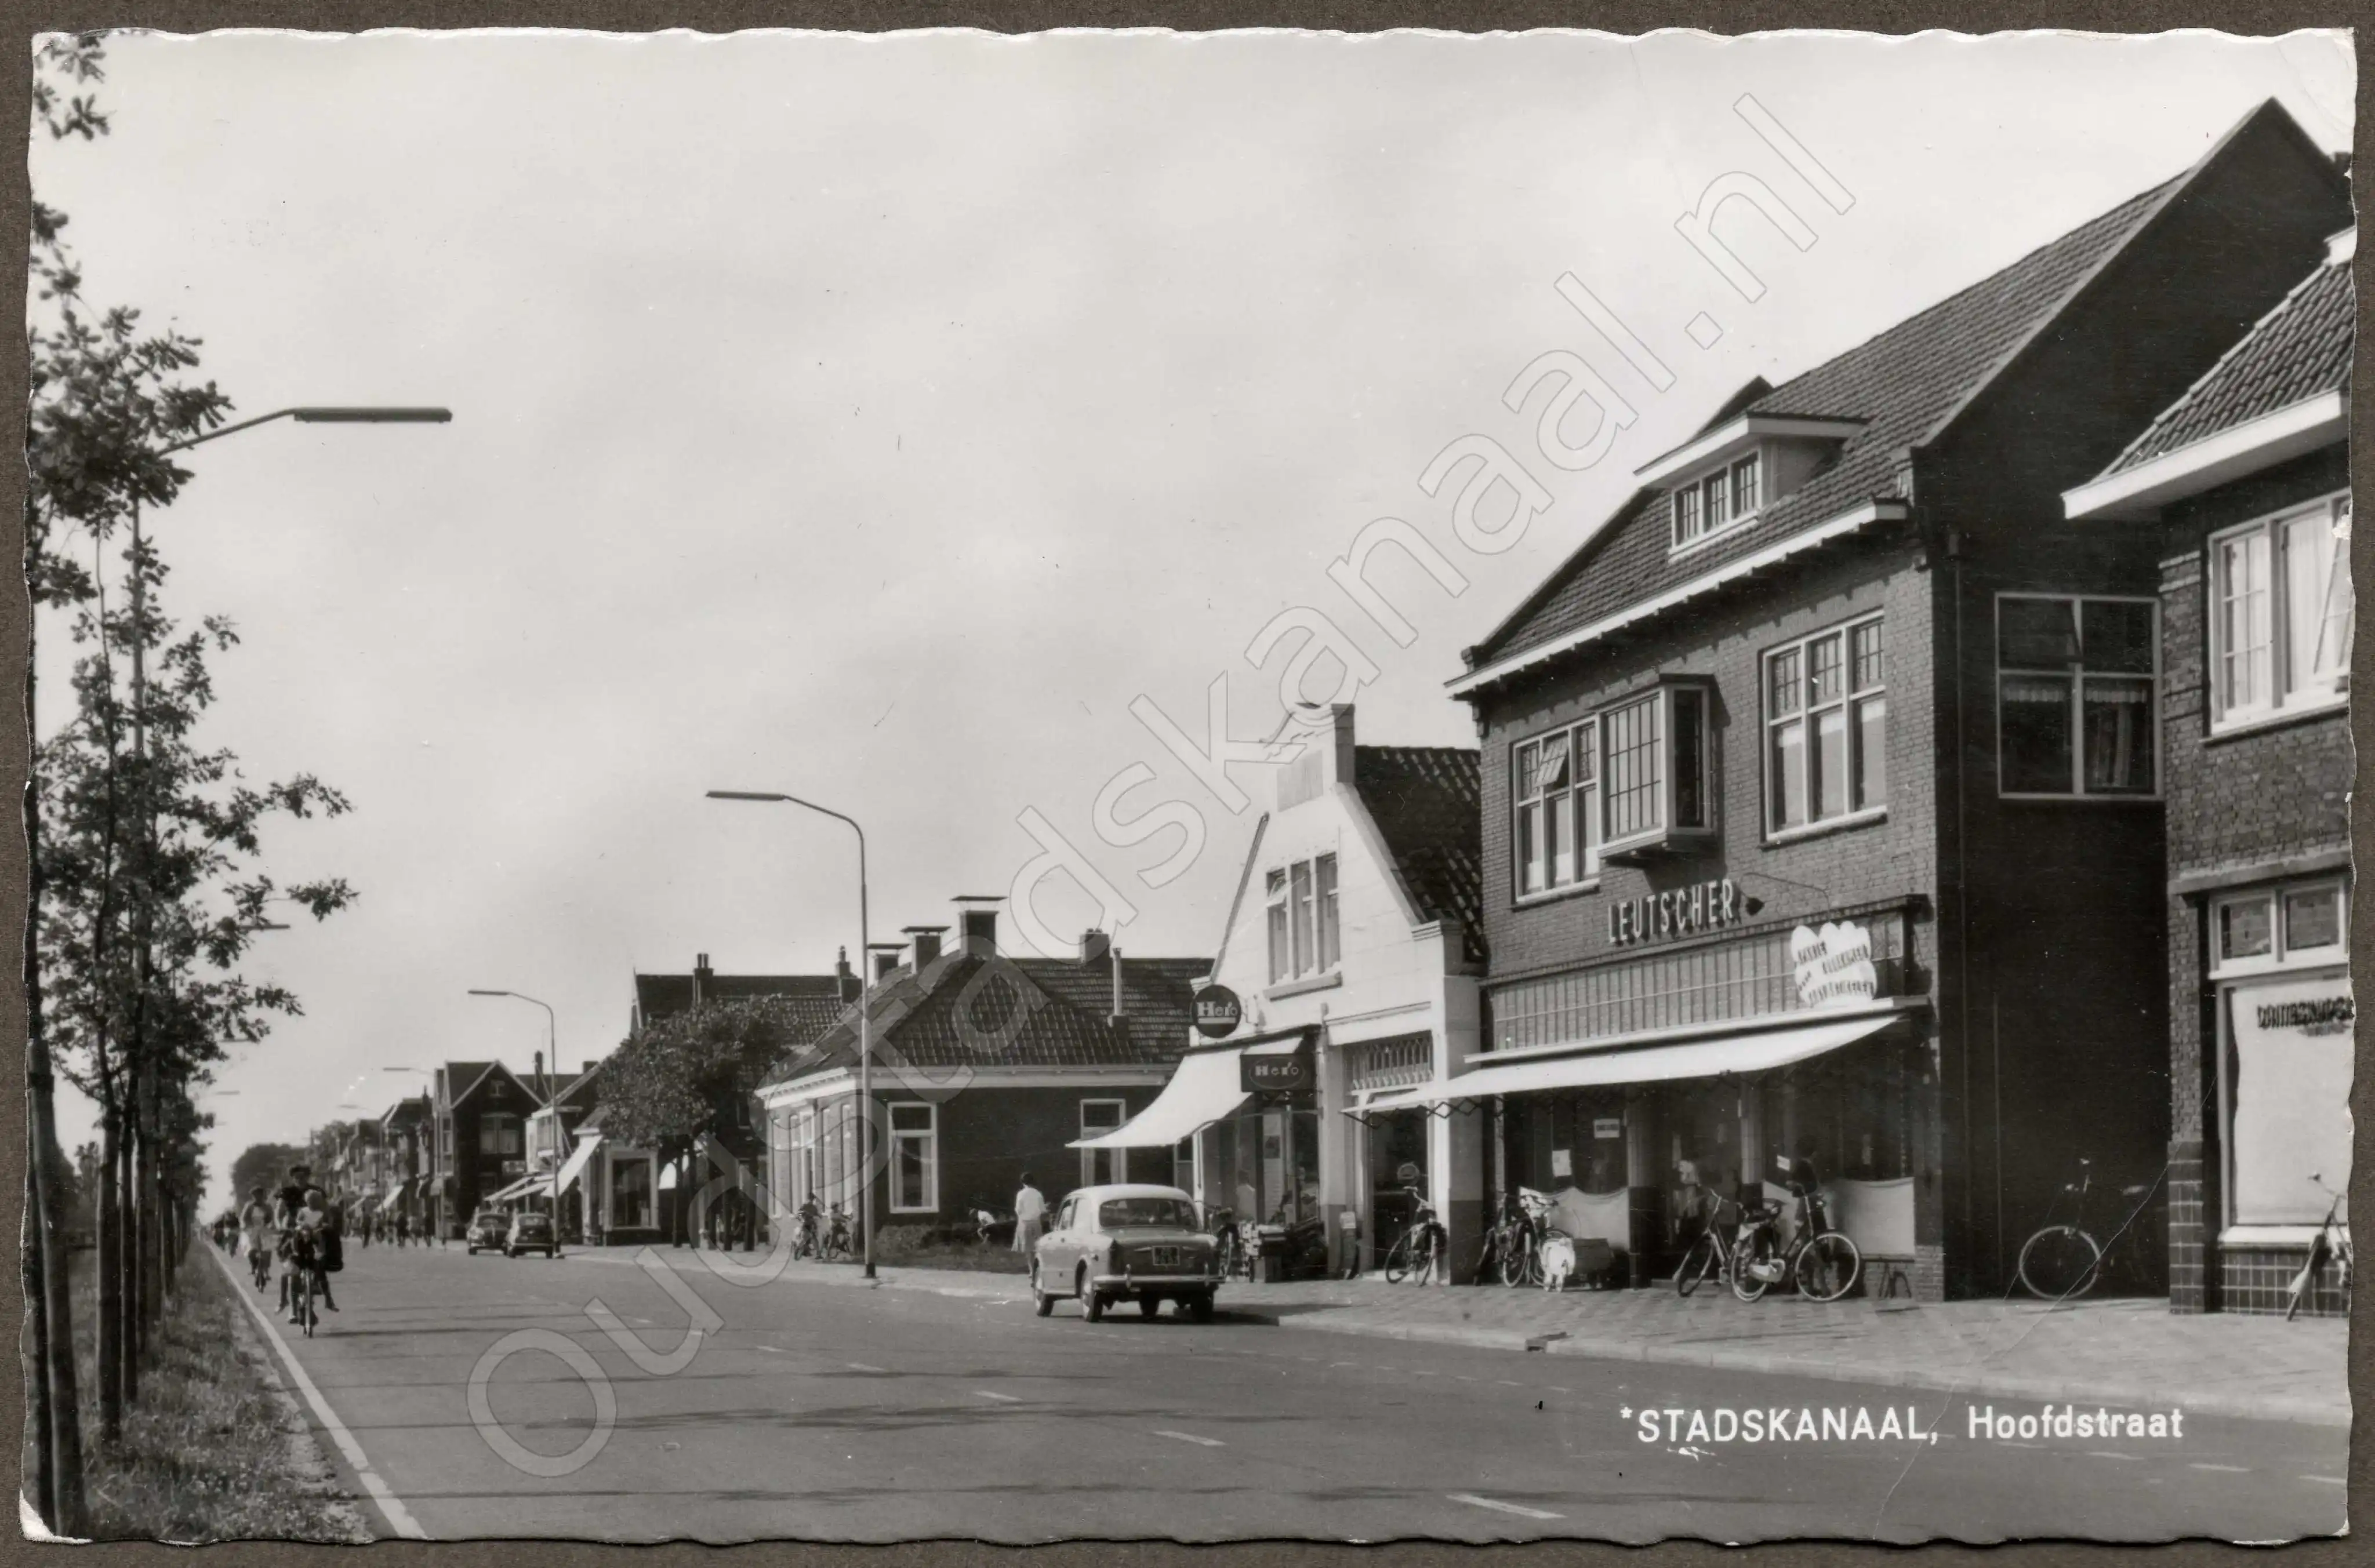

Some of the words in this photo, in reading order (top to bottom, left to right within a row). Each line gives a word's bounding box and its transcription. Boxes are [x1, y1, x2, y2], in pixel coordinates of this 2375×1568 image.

[1608, 879, 1734, 943] LEUTSCHER
[1197, 1001, 1237, 1016] Hero
[1255, 1062, 1299, 1076] Hero
